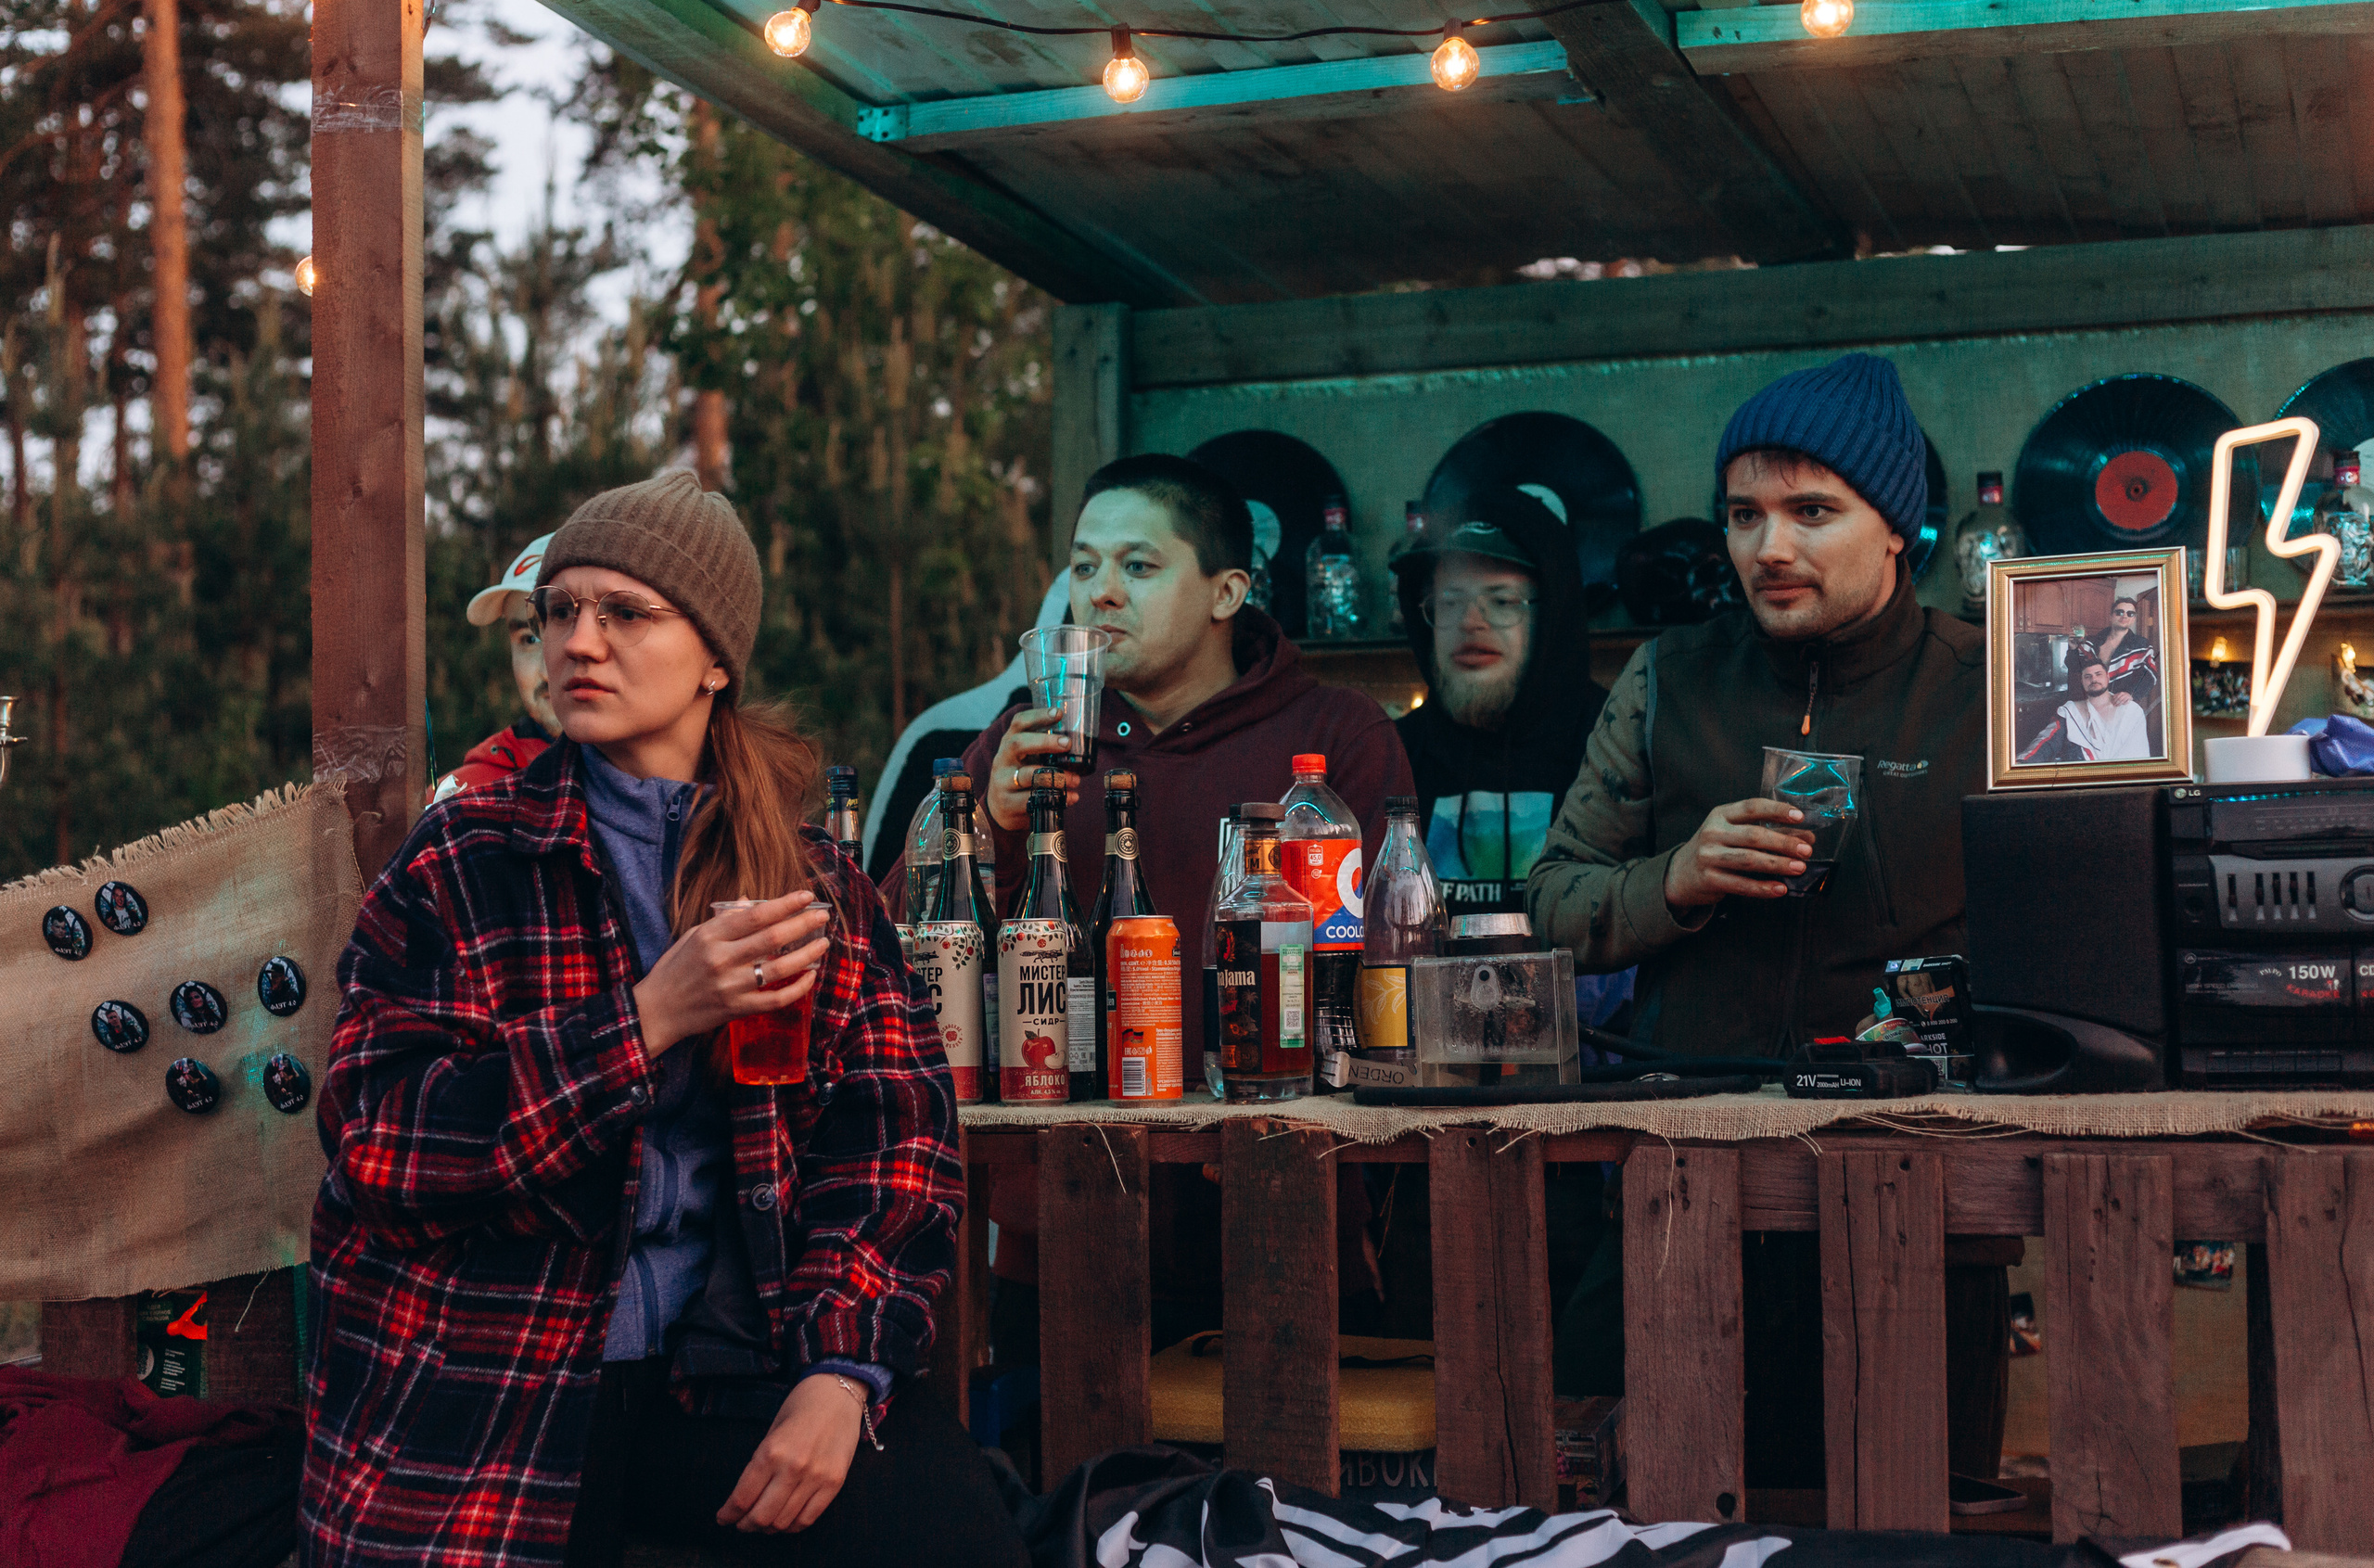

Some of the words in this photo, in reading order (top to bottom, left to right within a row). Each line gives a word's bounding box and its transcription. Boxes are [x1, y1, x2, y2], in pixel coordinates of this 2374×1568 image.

[1877, 759, 1916, 771] Regatta
[1455, 883, 1501, 902] PATH
[1019, 964, 1066, 981] МИСТЕР
[2289, 965, 2336, 979] 150W
[1016, 981, 1066, 1015] ЛИС
[1032, 1017, 1060, 1026] СИДР
[1921, 1032, 1946, 1041] ARKSIDE
[1926, 1042, 1948, 1054] HOT
[1025, 1074, 1066, 1087] ЯБЛОКО
[1348, 1064, 1405, 1085] ORDEN
[1796, 1074, 1817, 1087] 21V
